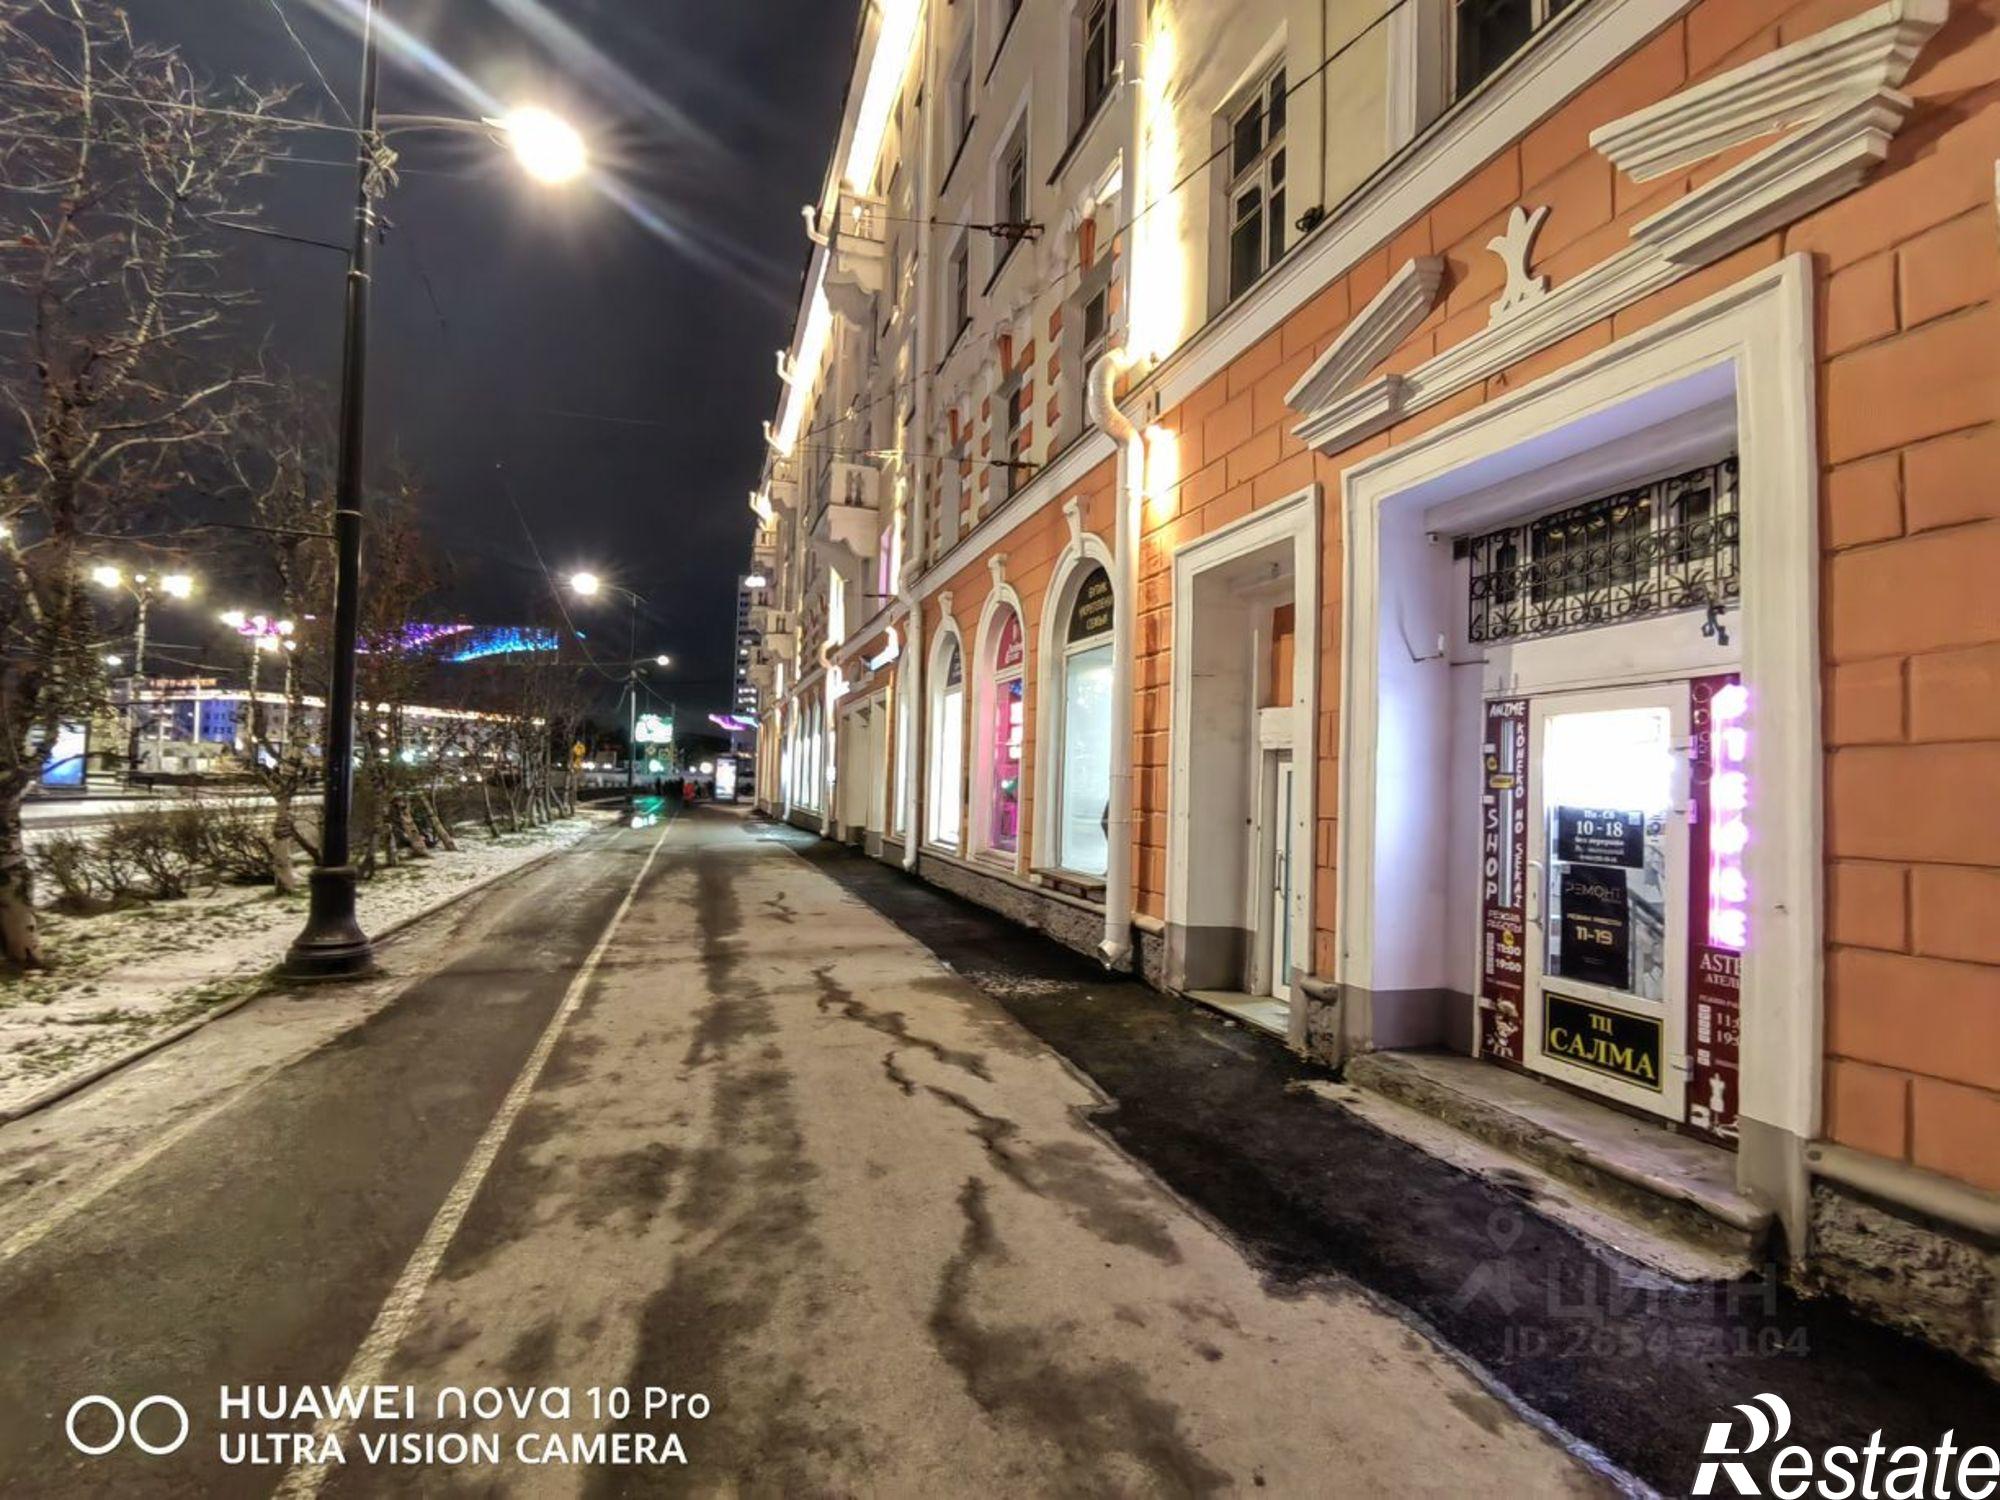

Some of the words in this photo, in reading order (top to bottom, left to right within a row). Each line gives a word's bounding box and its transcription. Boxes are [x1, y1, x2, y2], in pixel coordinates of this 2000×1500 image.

[1576, 820, 1594, 836] 10
[1606, 821, 1624, 838] 18
[1486, 808, 1499, 900] SHOP
[1575, 925, 1613, 946] 11-19
[1550, 1027, 1656, 1079] САЛМА
